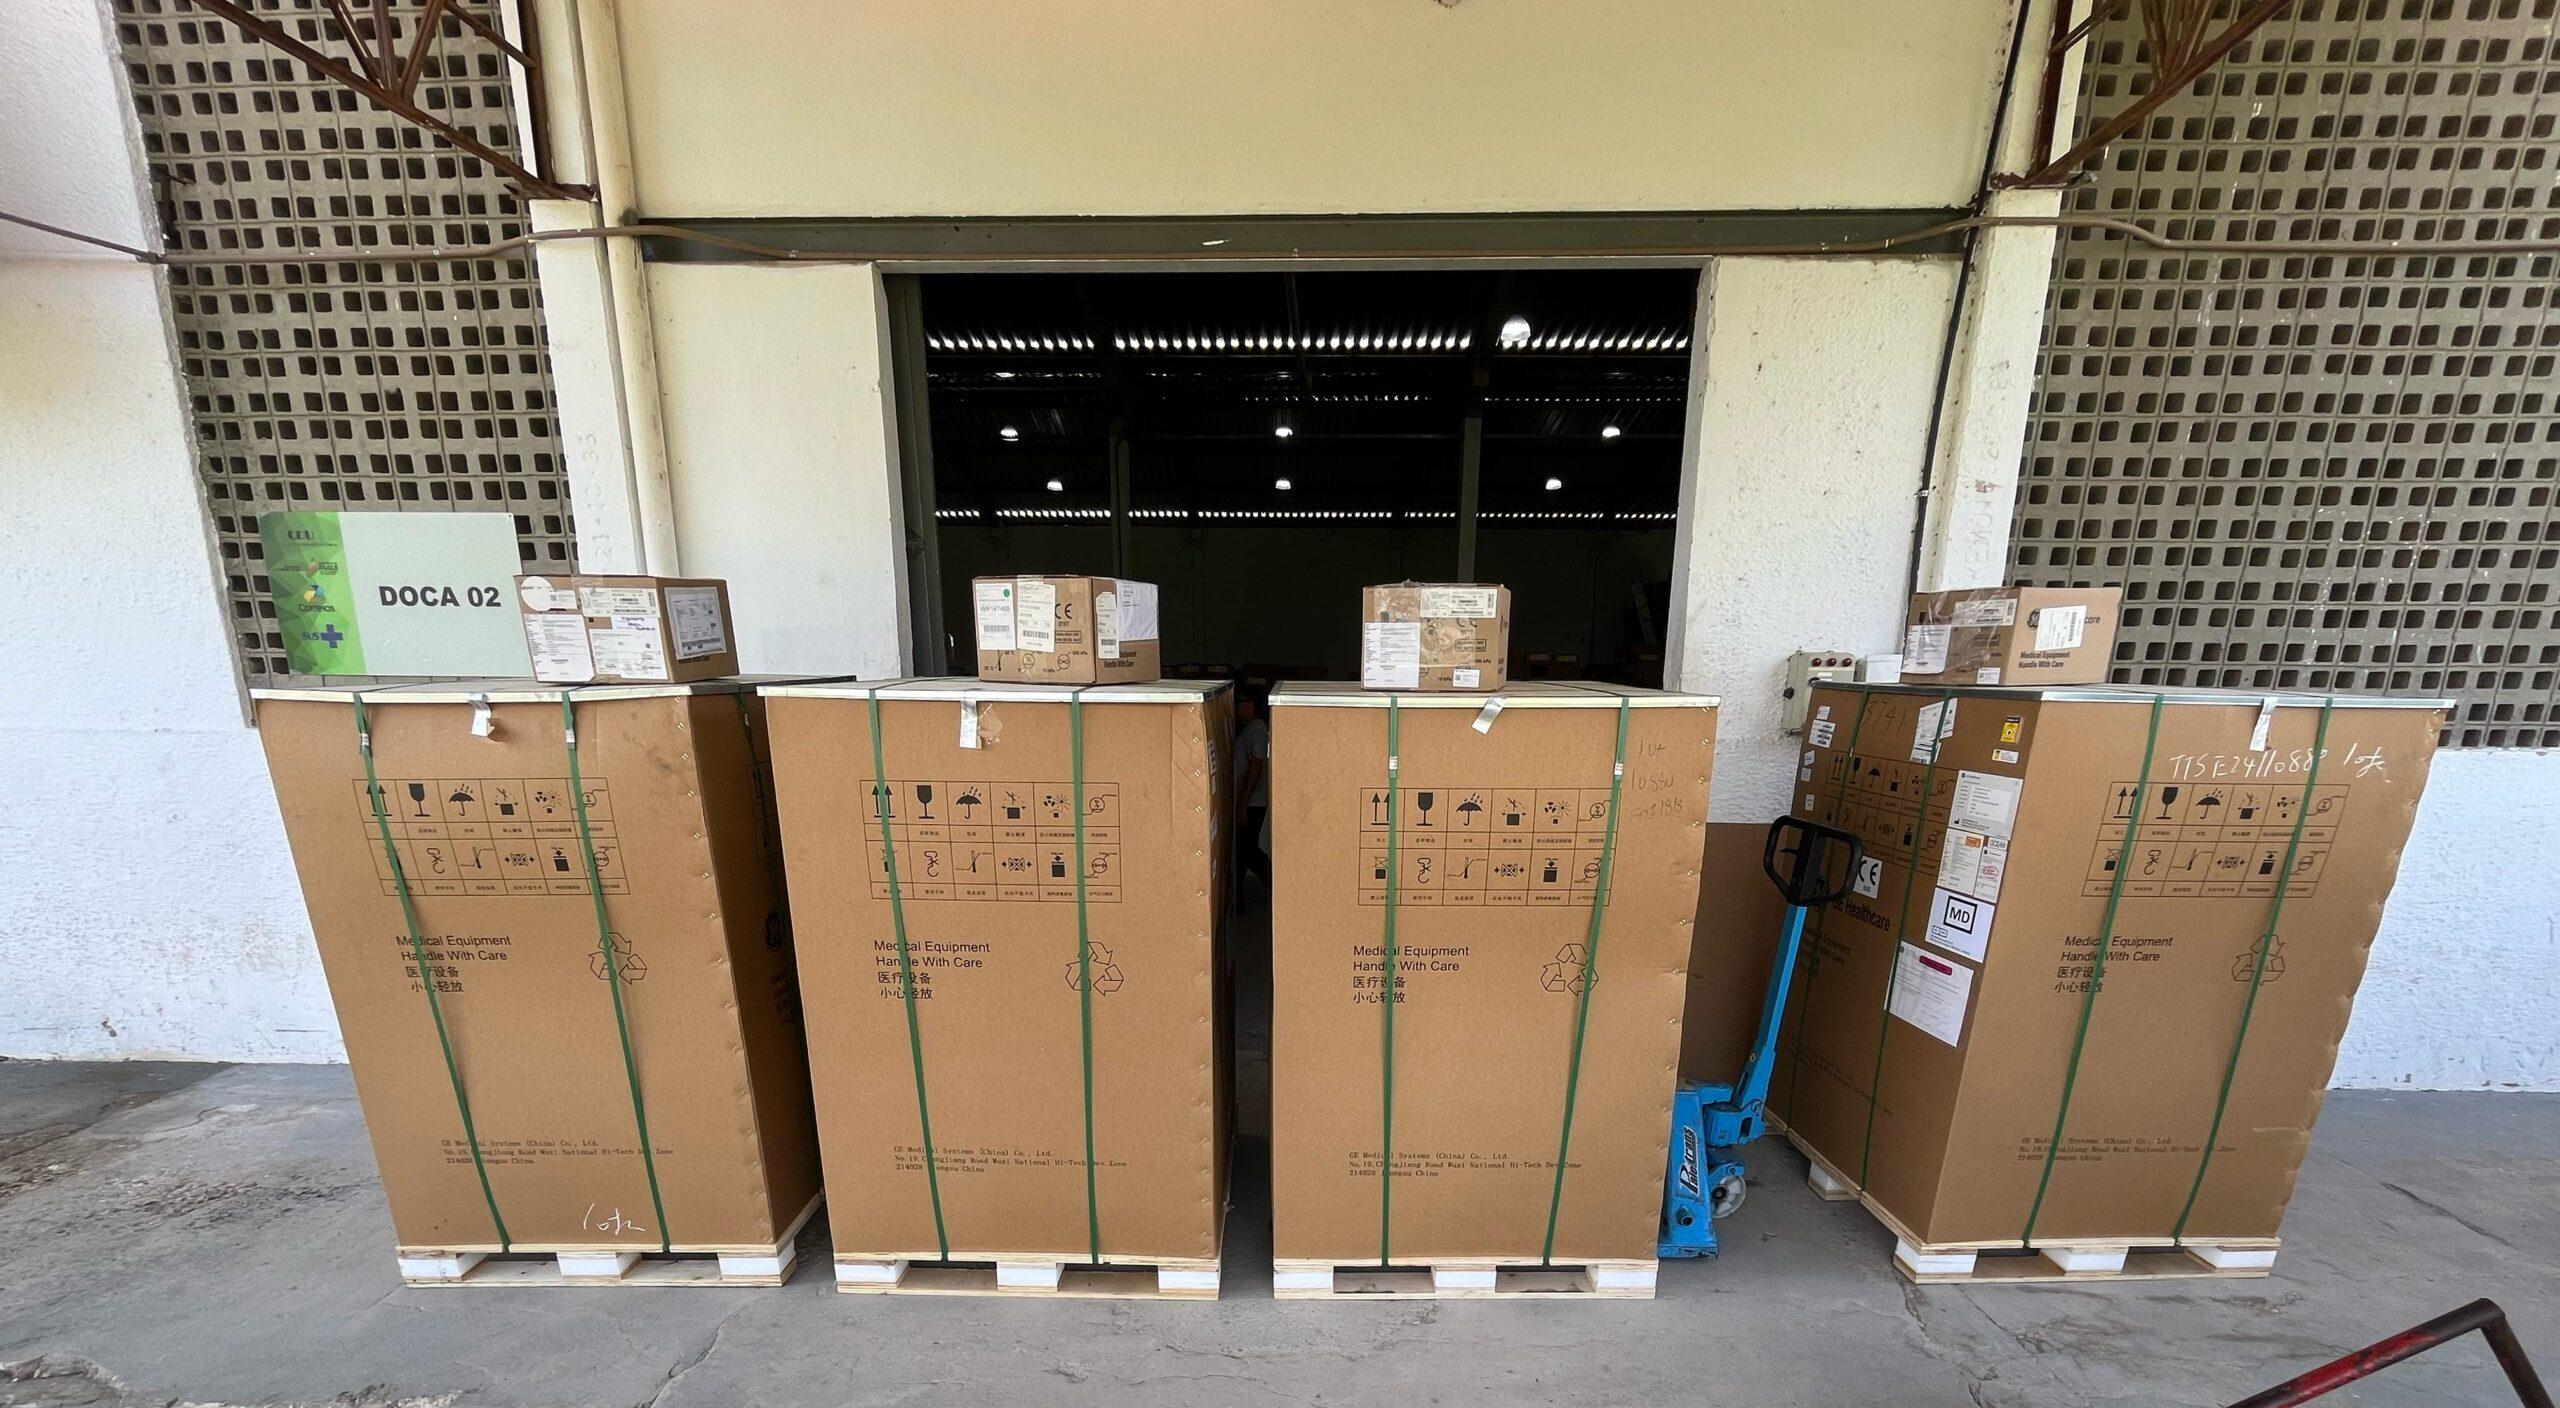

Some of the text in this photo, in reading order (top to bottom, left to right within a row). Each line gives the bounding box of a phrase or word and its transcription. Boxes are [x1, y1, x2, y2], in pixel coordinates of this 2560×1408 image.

[378, 586, 502, 607] DOCA 02
[1846, 898, 1890, 932] Healthcare
[1950, 906, 1970, 924] MD
[446, 936, 512, 948] Equipment
[924, 941, 990, 954] Equipment
[2112, 936, 2174, 948] Equipment
[446, 951, 475, 961] With
[478, 950, 507, 961] Care
[1404, 946, 1470, 958] Equipment
[2104, 952, 2130, 961] With
[2132, 951, 2160, 961] Care
[922, 956, 950, 967] With
[954, 957, 983, 968] Care
[1400, 961, 1427, 971] With
[1430, 961, 1460, 971] Care
[980, 1148, 1008, 1156] (China)
[1399, 1152, 1430, 1160] Systems
[1436, 1152, 1465, 1160] (China)
